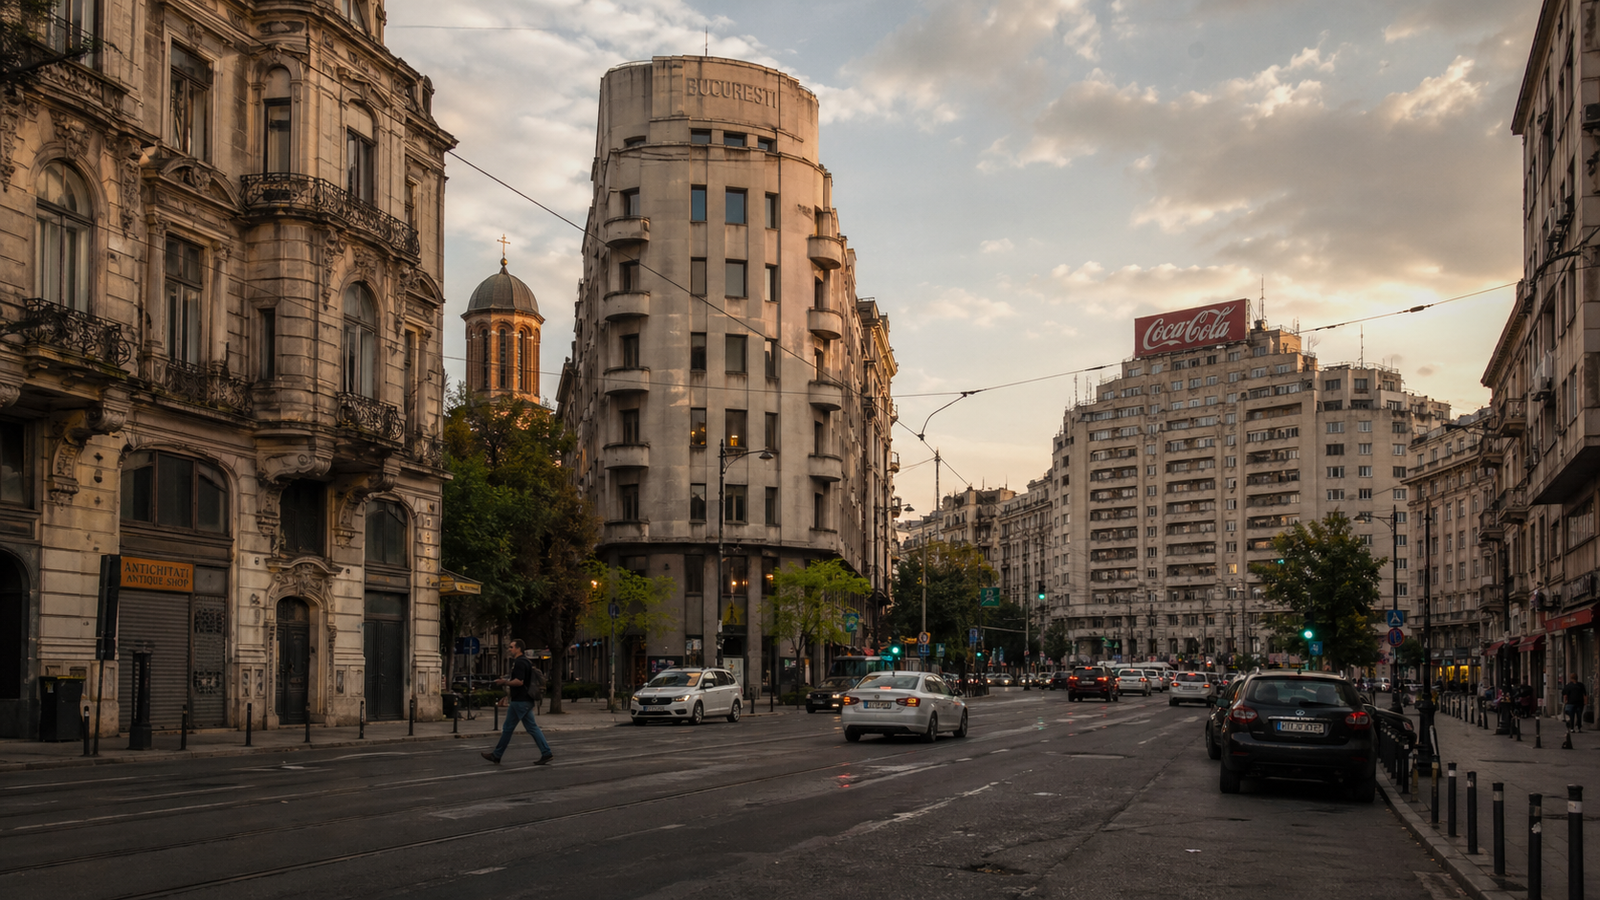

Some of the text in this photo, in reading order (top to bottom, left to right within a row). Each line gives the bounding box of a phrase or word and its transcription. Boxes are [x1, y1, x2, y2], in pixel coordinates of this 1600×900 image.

[124, 562, 190, 579] ANTICHITATI
[126, 574, 189, 588] ANTIQUE SHOP
